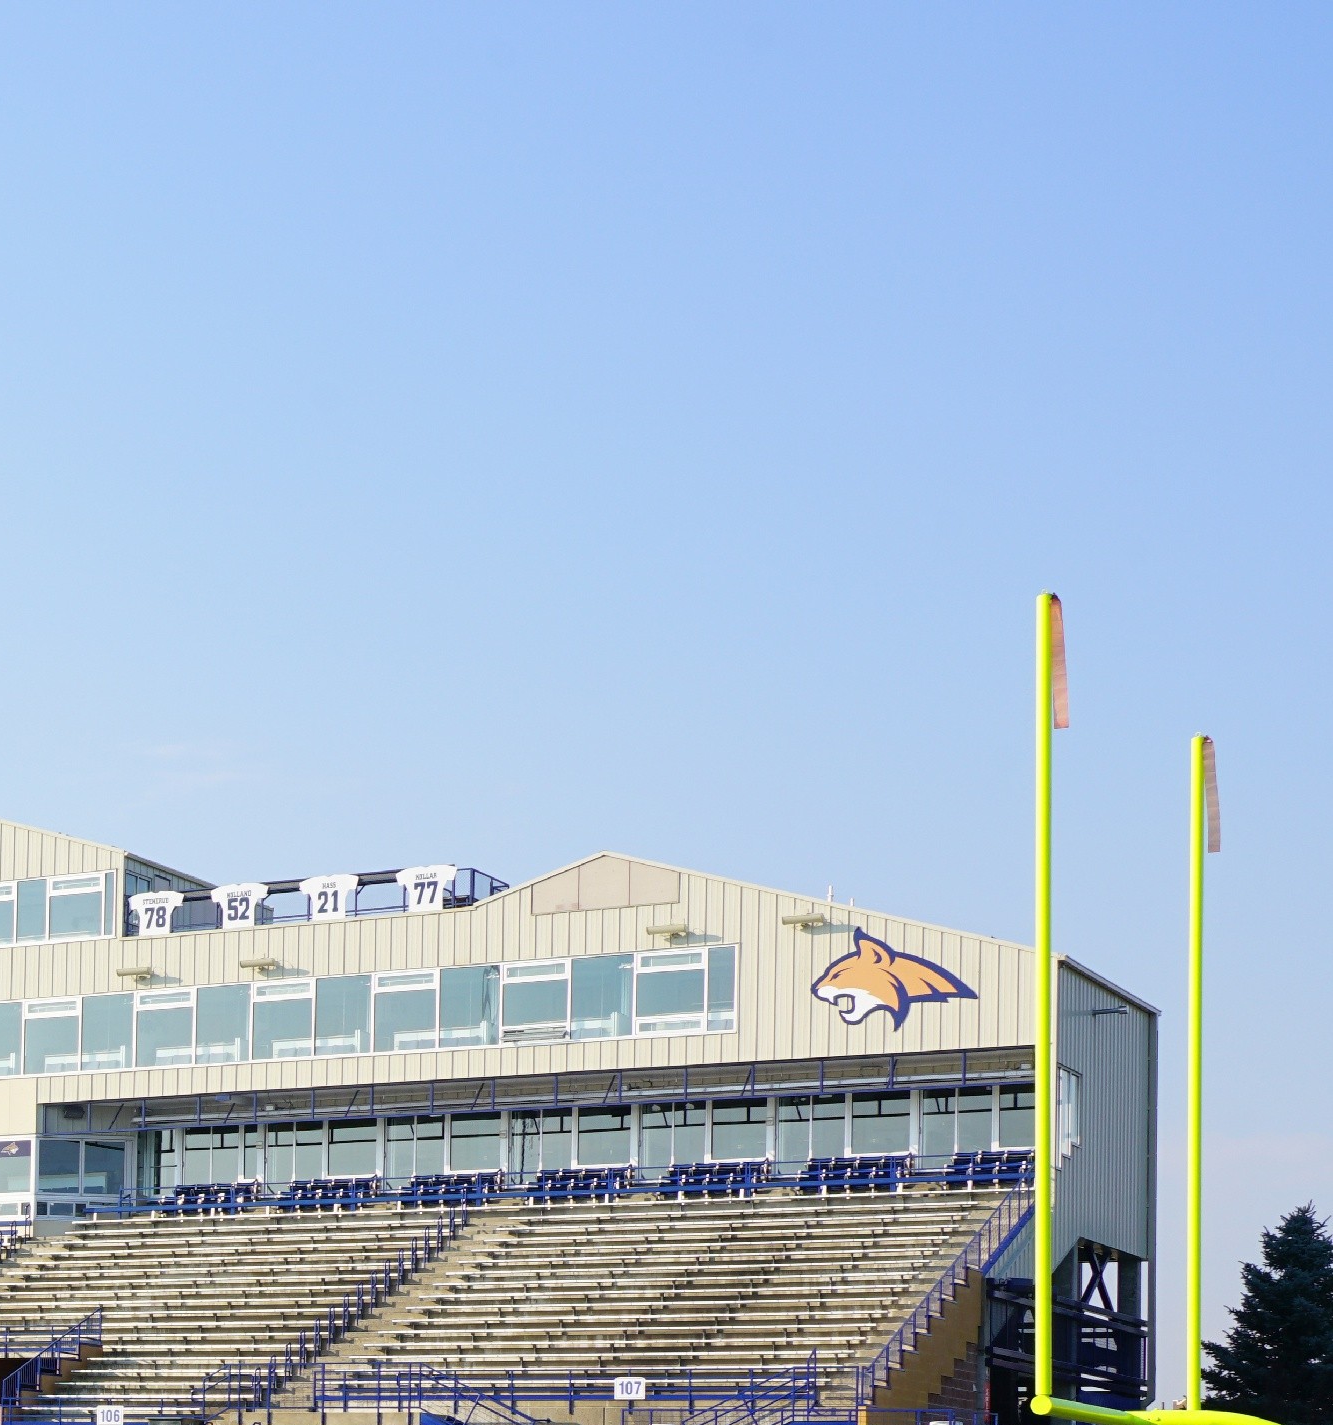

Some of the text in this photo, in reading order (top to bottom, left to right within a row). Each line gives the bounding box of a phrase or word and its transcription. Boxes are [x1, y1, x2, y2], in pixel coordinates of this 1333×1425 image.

[317, 890, 338, 913] 21
[414, 881, 438, 905] 77
[145, 906, 166, 929] 78
[228, 897, 250, 921] 52
[619, 1381, 642, 1395] 107
[101, 1409, 120, 1422] 106
